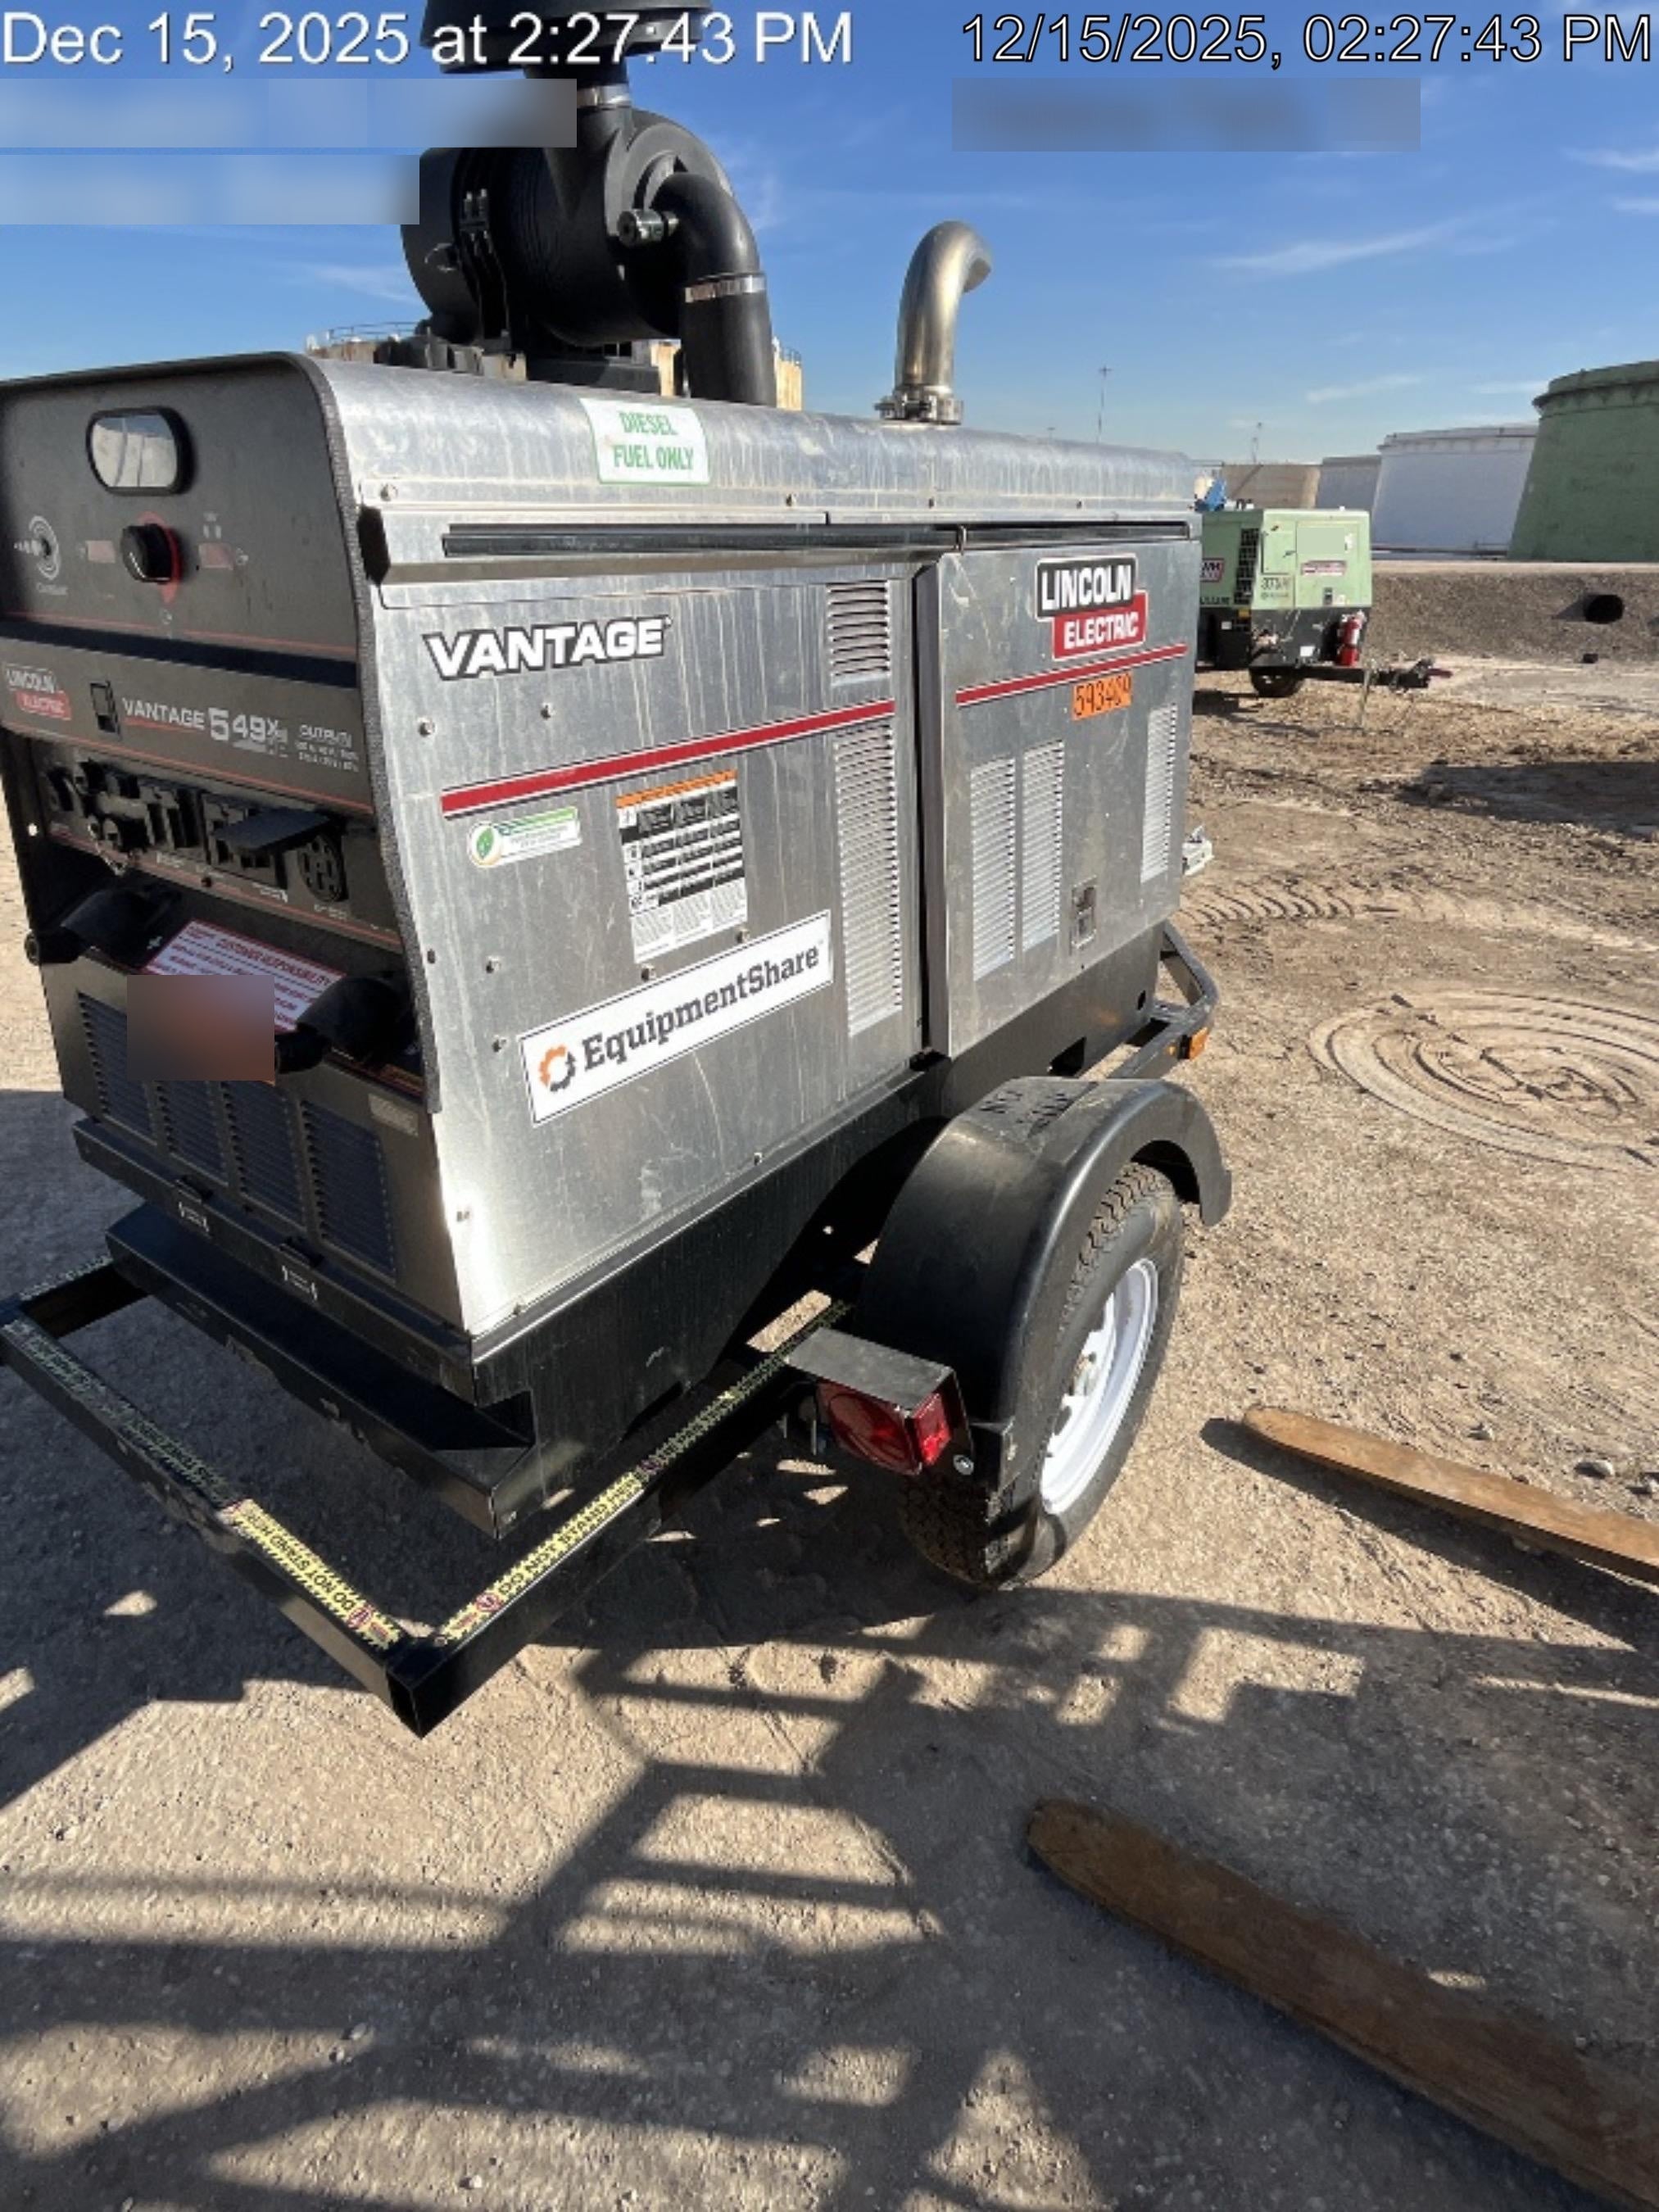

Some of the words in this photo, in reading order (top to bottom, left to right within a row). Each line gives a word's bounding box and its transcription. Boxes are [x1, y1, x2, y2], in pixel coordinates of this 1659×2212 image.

[619, 411, 679, 436] DIESEL
[613, 445, 654, 469] FUEL
[656, 447, 694, 470] ONLY
[1041, 564, 1133, 610] LINCOLN
[1063, 611, 1140, 650] ELECTRIC
[422, 615, 669, 682] VANTAGE
[122, 696, 205, 731] VANTAGE
[581, 945, 819, 1072] EquipmentShare
[306, 1570, 335, 1594] NOT
[332, 1591, 356, 1611] DO
